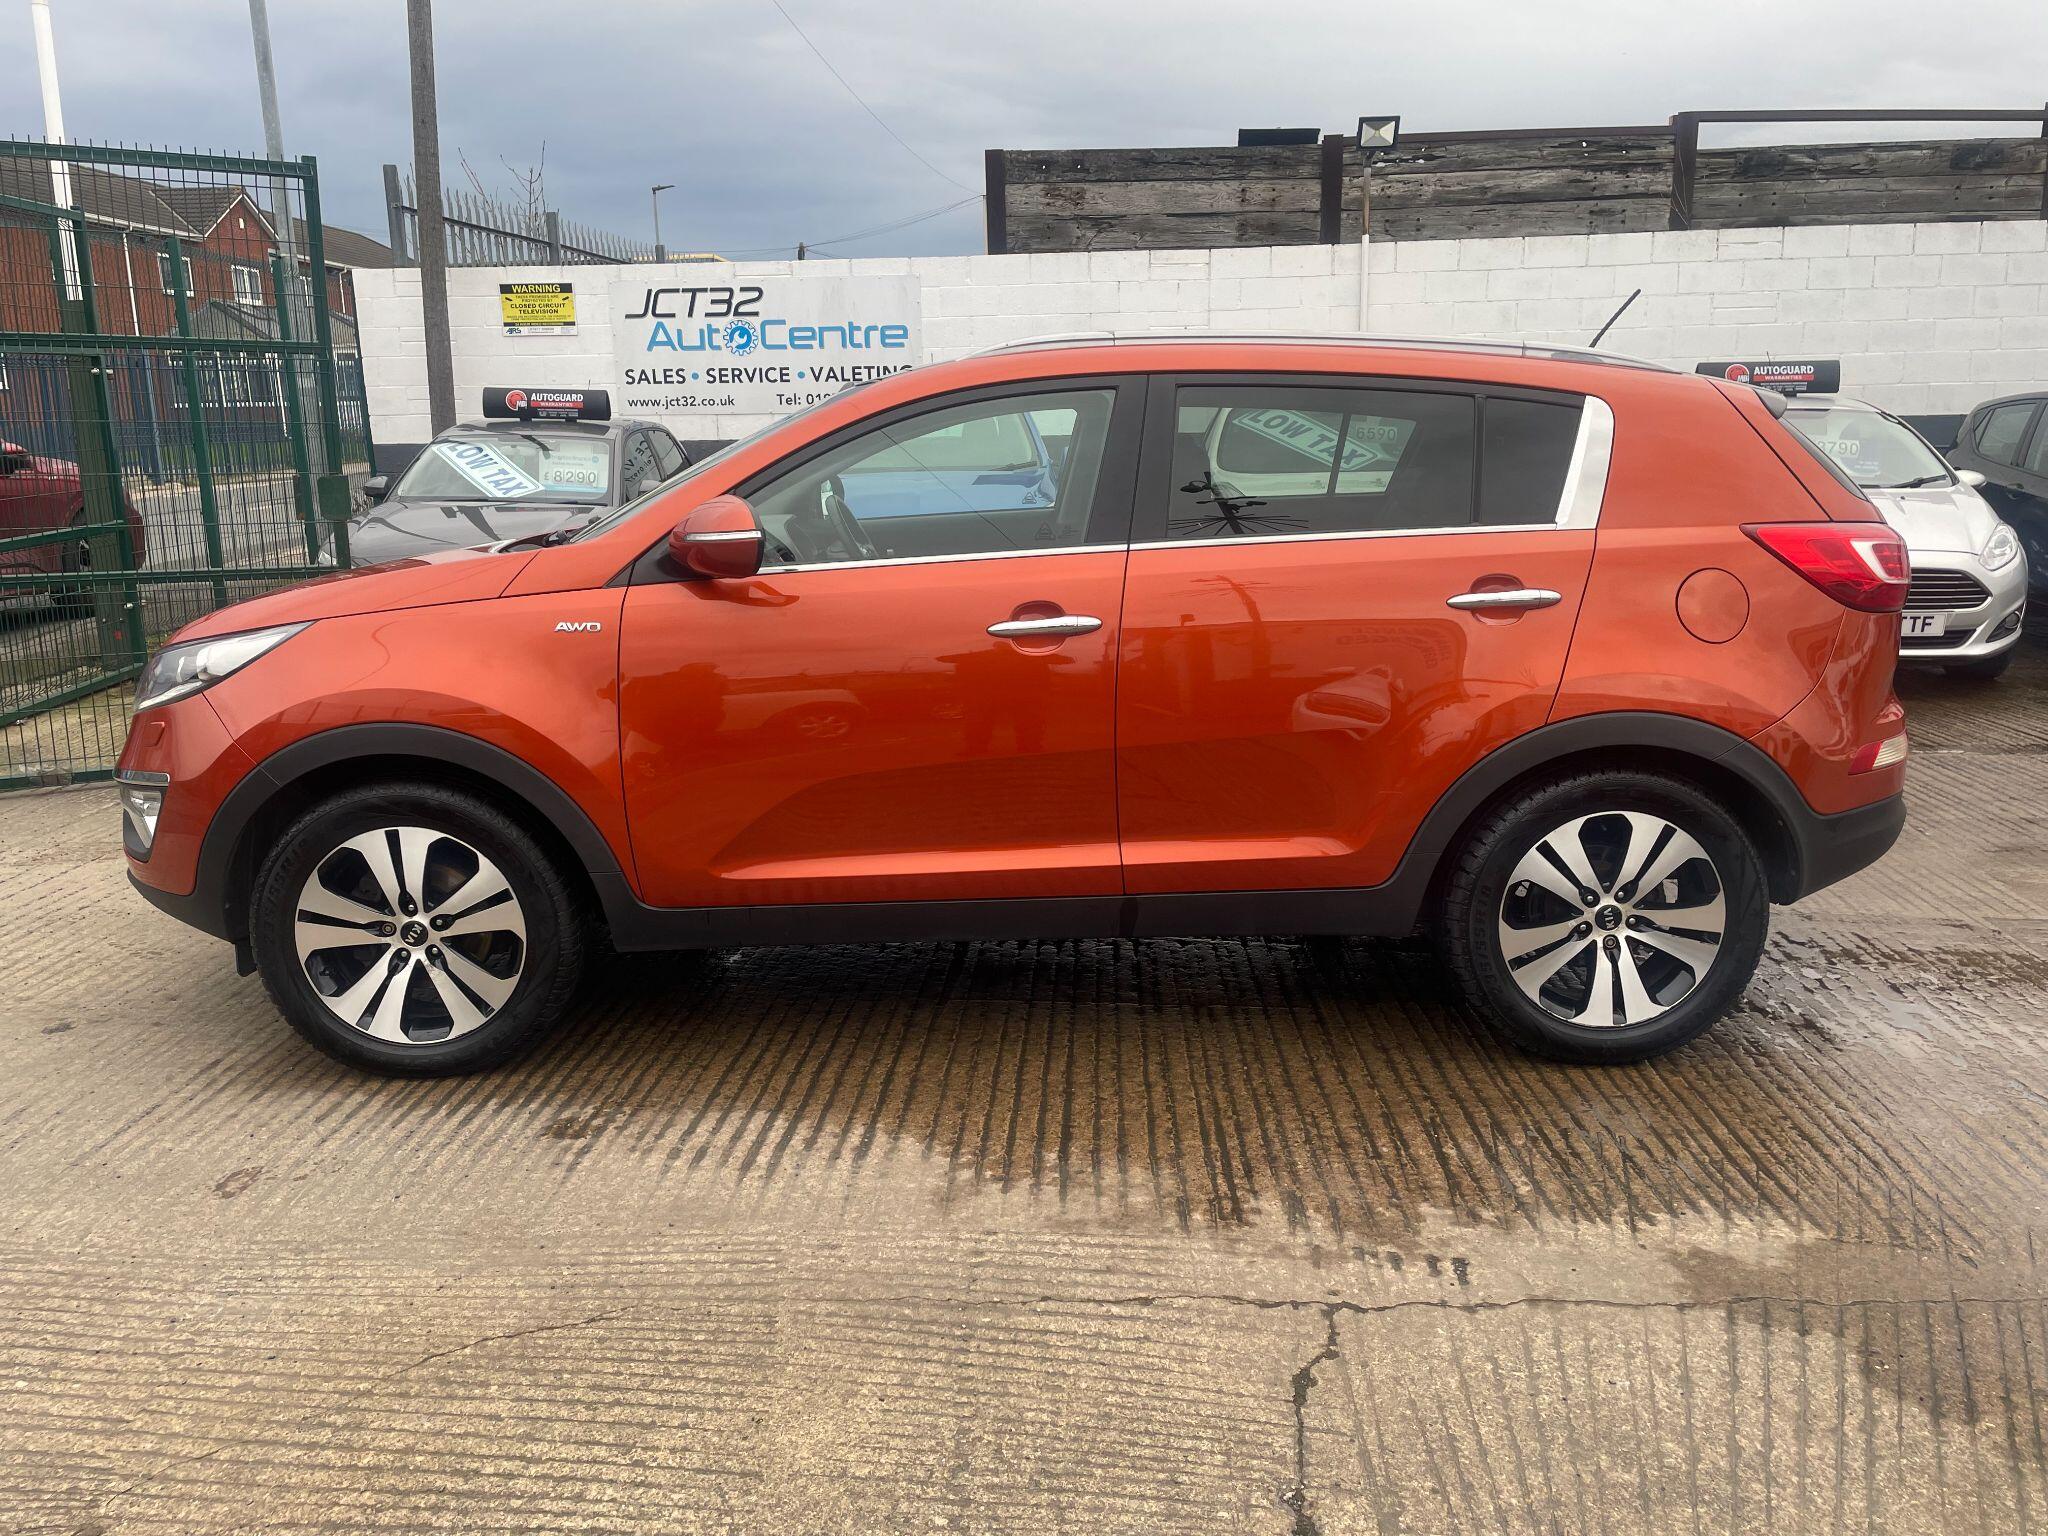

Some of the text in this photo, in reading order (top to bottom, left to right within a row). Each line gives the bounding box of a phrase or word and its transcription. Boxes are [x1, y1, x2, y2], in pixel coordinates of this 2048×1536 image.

[511, 284, 561, 293] WARNING
[624, 286, 764, 319] JCT32
[624, 368, 687, 385] SALES
[705, 366, 791, 384] SERVICE
[1753, 365, 1815, 375] AUTOGUARD
[530, 392, 584, 402] AUTOGUARD
[627, 395, 735, 410] www.jct32.co.uk
[776, 393, 802, 406] Tel:
[1250, 409, 1314, 439] LOW
[446, 443, 529, 496] LOW TAX
[404, 923, 423, 943] KIA
